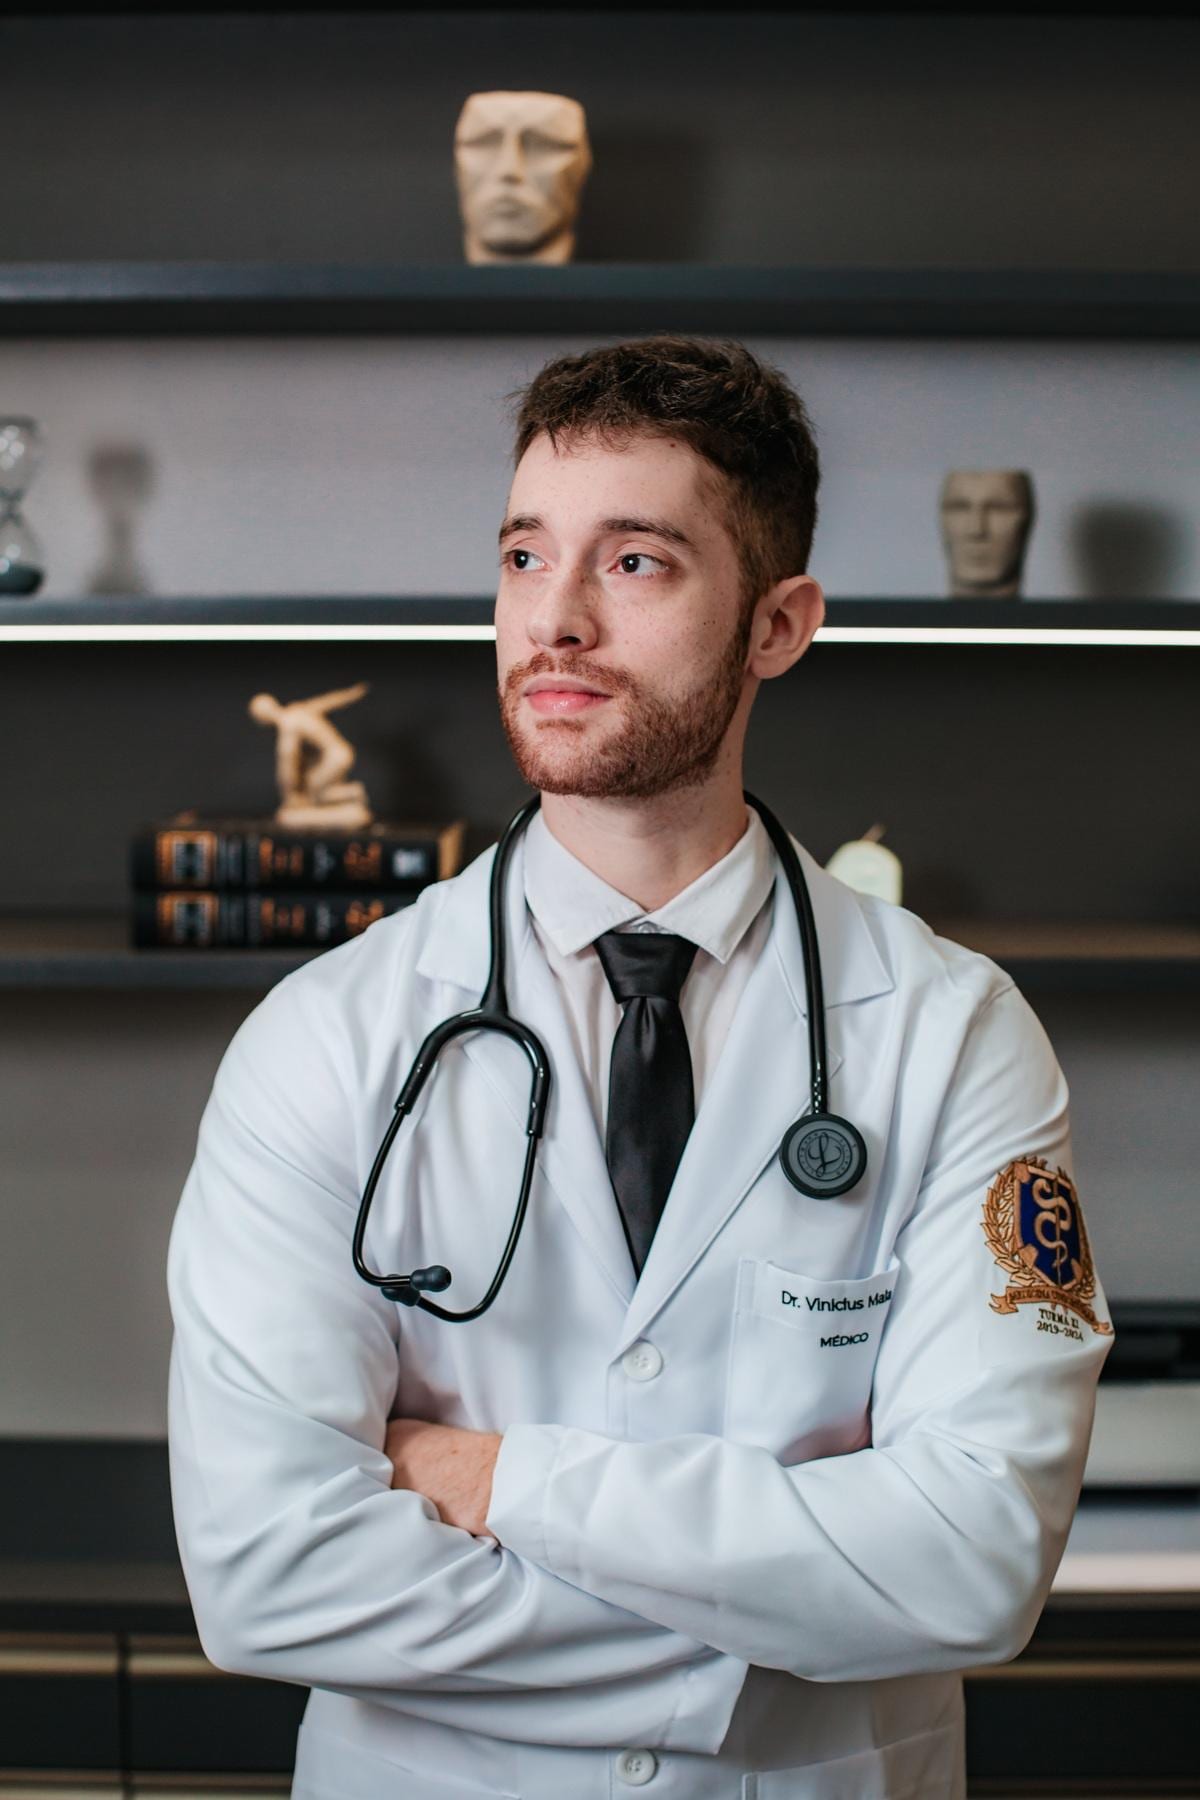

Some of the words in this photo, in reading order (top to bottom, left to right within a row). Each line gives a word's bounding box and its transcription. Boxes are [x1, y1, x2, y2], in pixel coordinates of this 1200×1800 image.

[782, 1290, 801, 1308] Dr.
[1038, 1308, 1070, 1326] TURMA
[820, 1332, 869, 1347] MÉDICO
